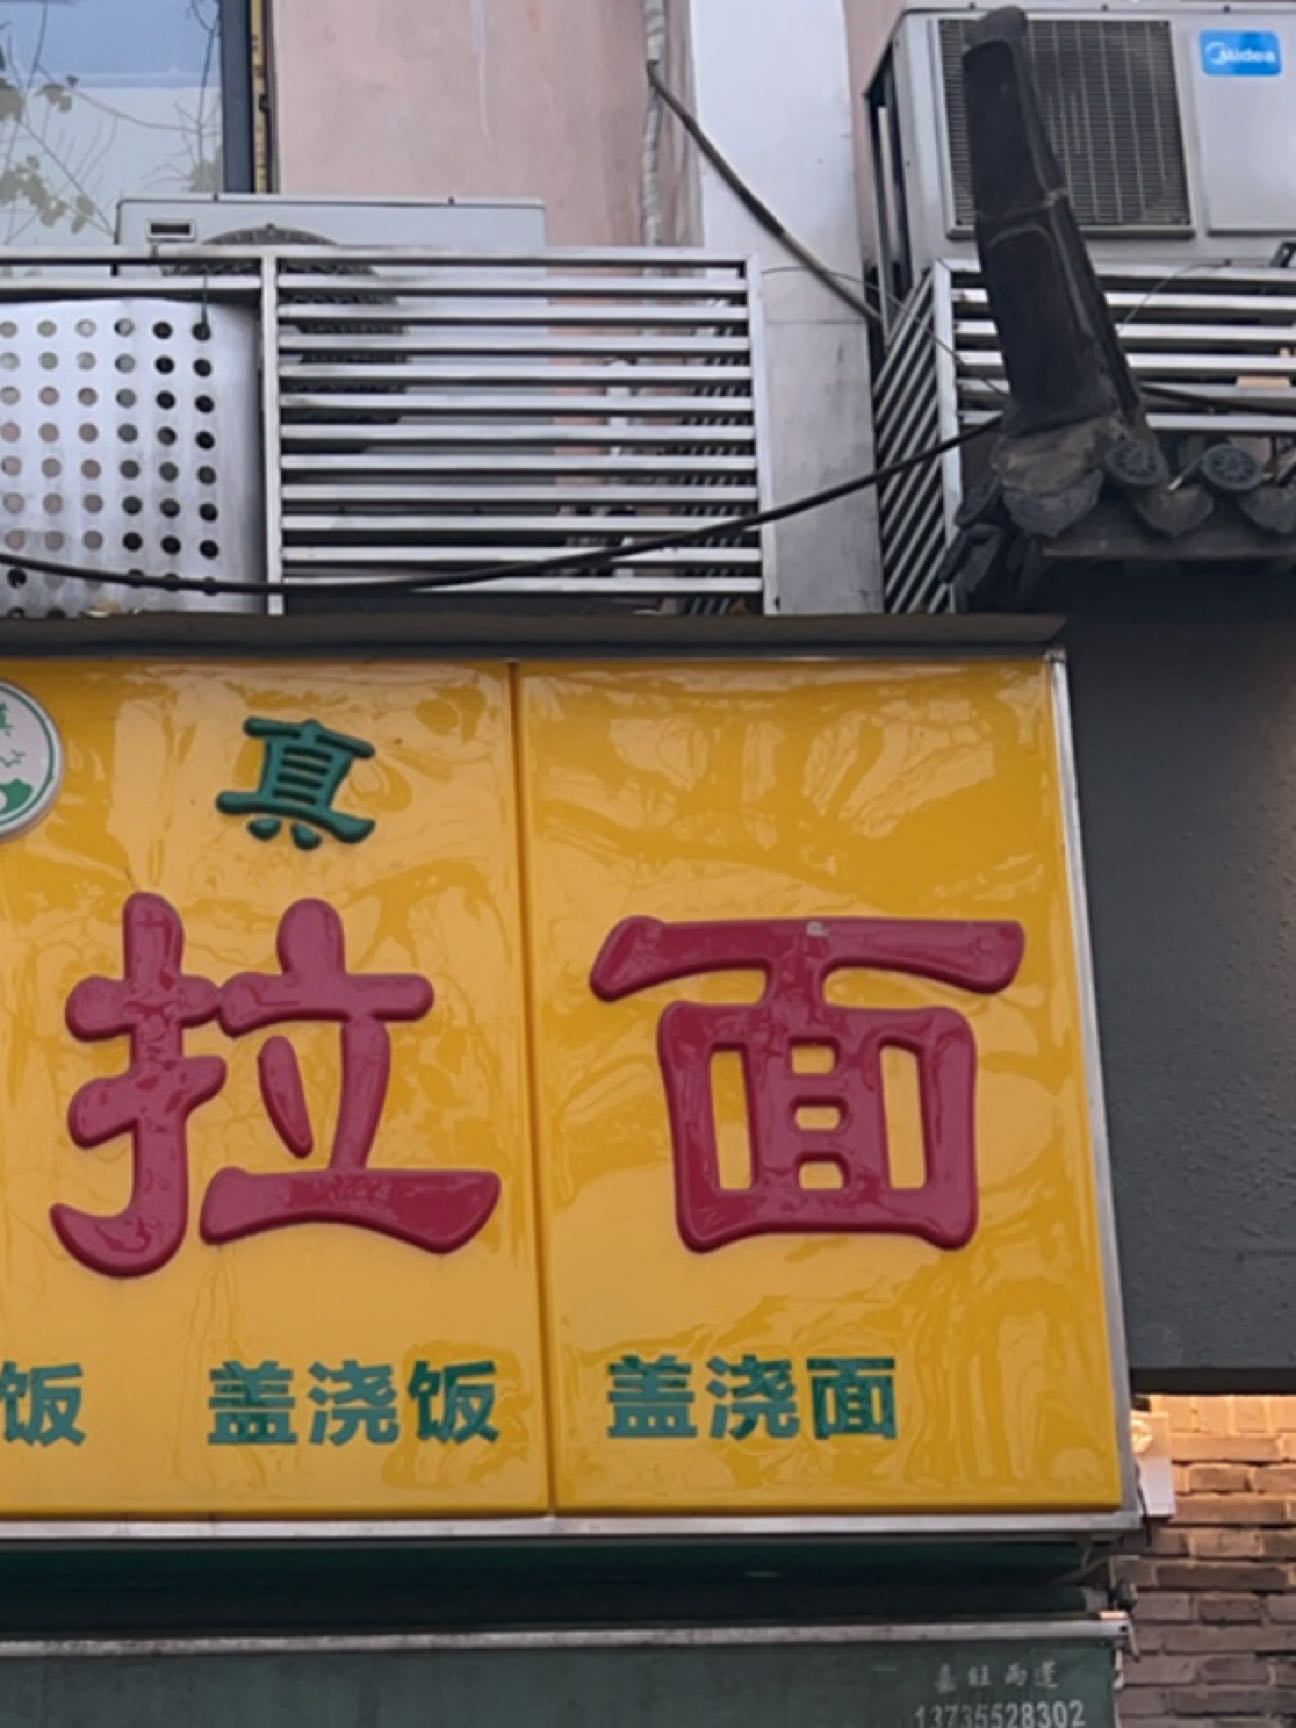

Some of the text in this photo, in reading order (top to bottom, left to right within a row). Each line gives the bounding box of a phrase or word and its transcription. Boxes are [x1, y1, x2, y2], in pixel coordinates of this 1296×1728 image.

[1219, 47, 1276, 64] Midea
[217, 717, 375, 850] 真
[207, 1360, 499, 1446] 盖浇饭
[607, 1354, 898, 1440] 盖浇面
